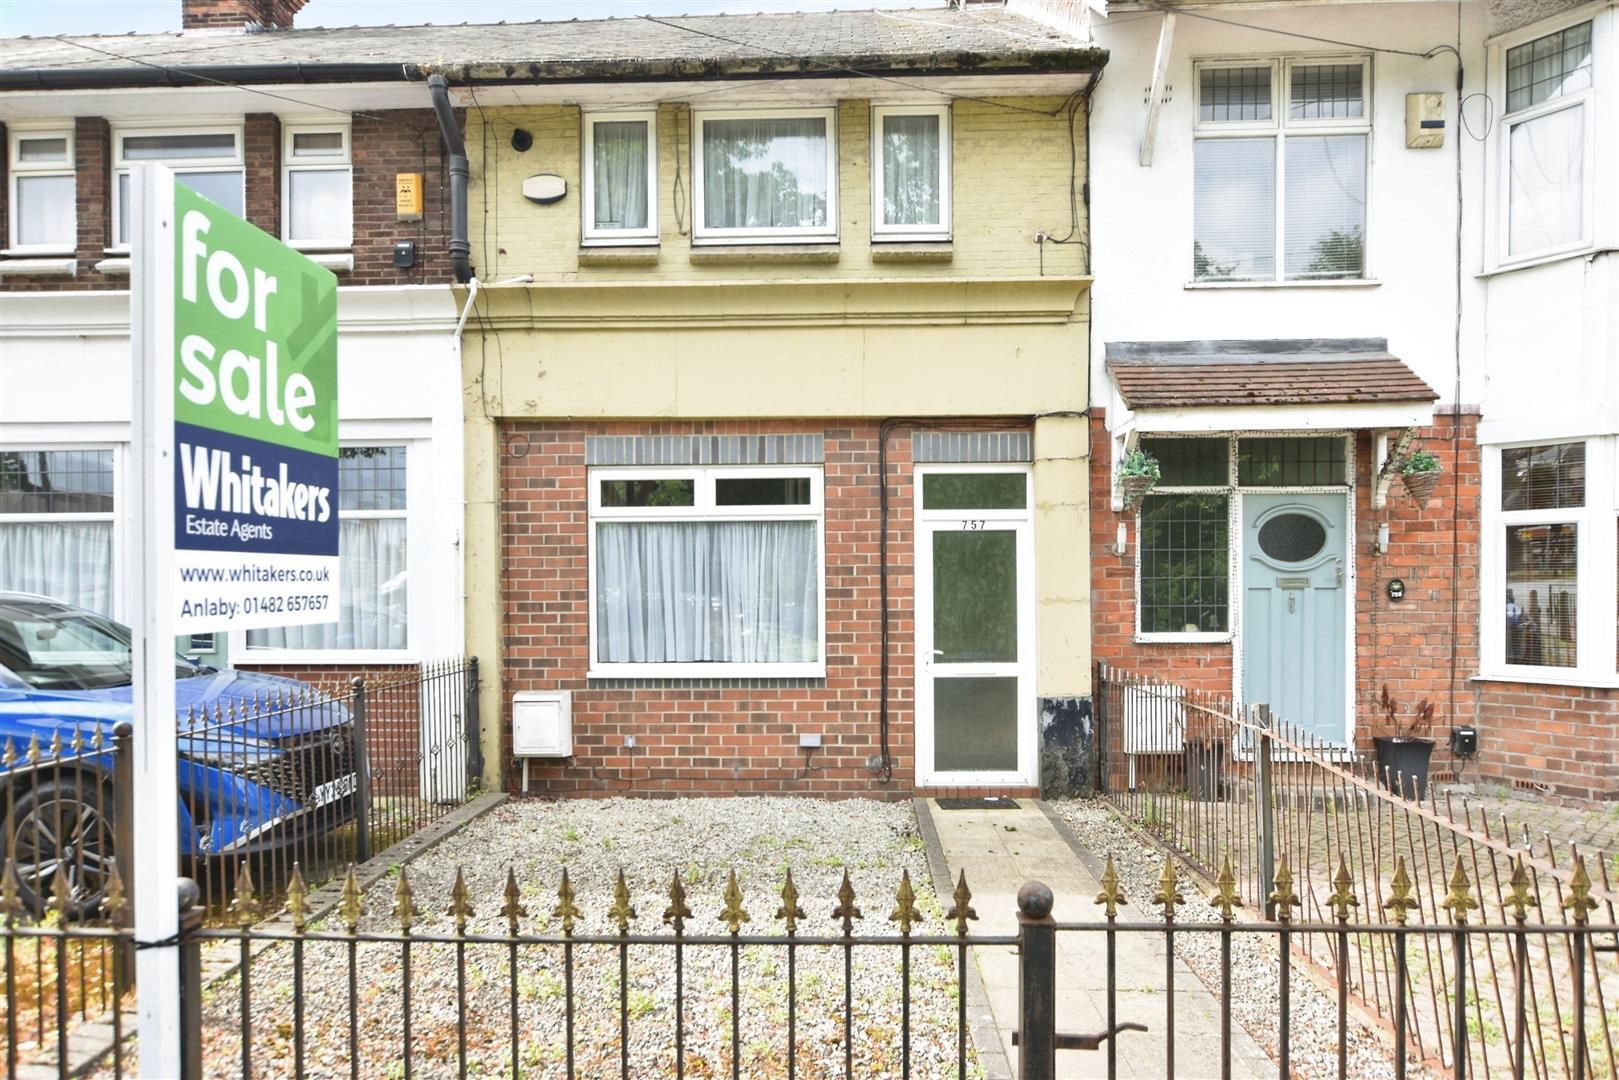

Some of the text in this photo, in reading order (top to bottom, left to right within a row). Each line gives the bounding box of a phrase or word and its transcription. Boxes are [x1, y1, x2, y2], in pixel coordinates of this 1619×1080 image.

[182, 210, 278, 333] for
[178, 334, 317, 432] sale
[179, 442, 331, 523] Whitakers
[185, 514, 273, 542] Estate Agents
[961, 519, 986, 530] 757
[180, 564, 330, 583] www.whitakers.co.uk
[180, 594, 329, 620] Anlaby: 01482 657657
